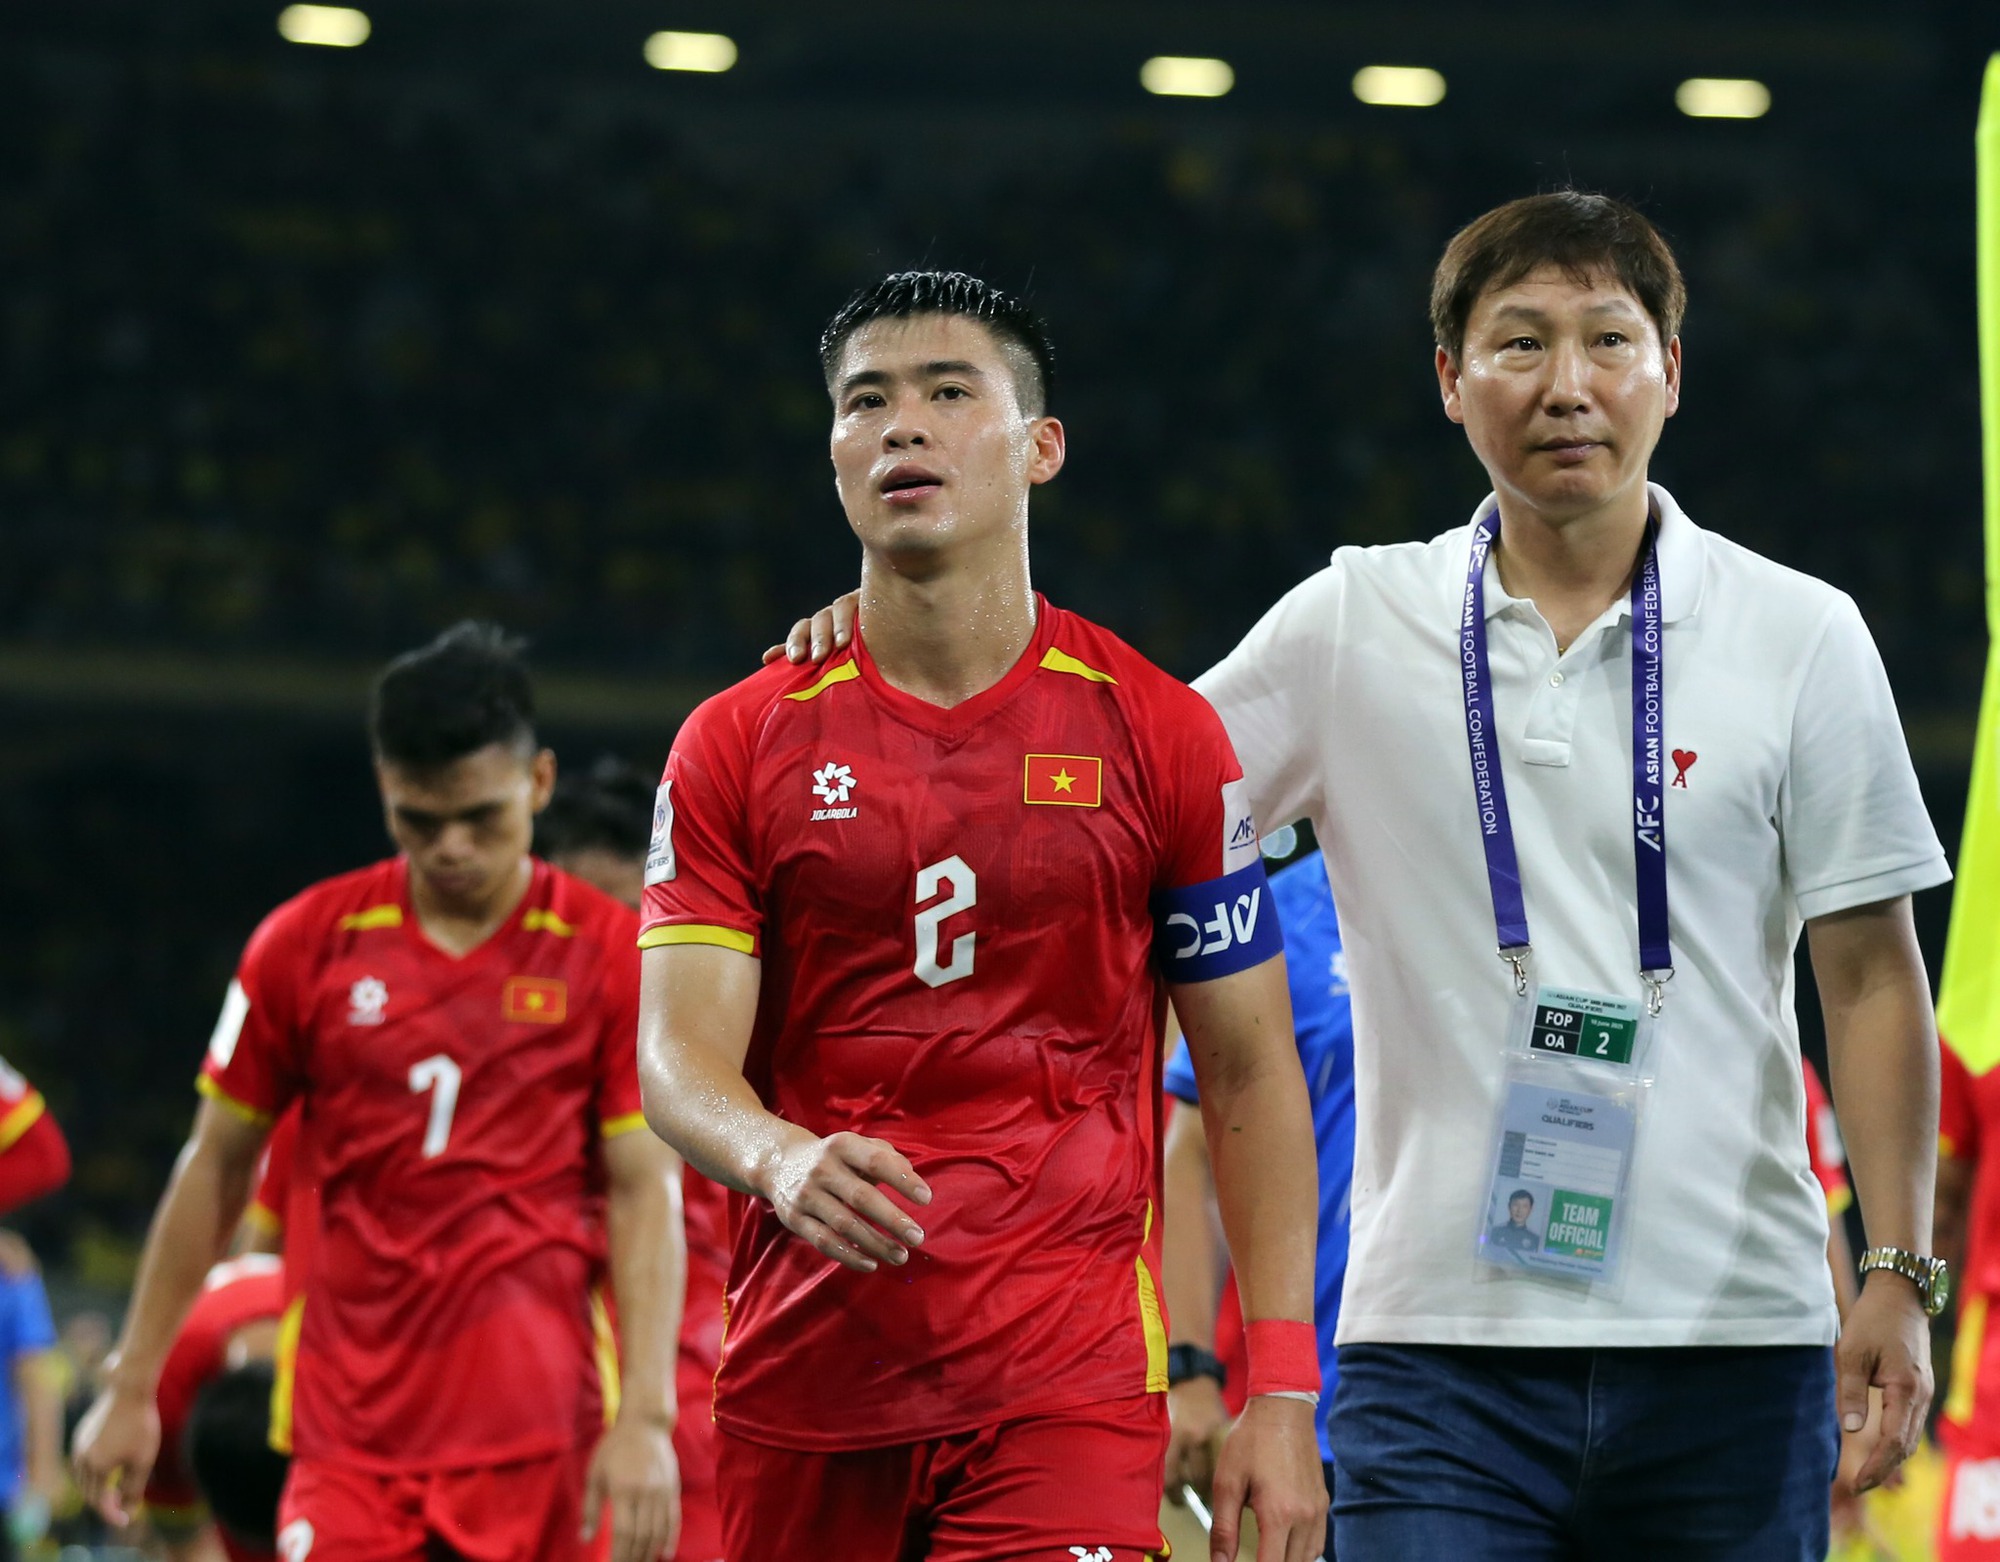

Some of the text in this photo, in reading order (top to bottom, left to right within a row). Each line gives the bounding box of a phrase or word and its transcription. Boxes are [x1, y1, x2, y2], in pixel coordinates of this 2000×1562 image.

[1463, 525, 1497, 835] AFC ASIAN FOOTBALL CONFEDERATION
[1645, 655, 1658, 733] FOOTBALL
[1647, 737, 1659, 785] ASIAN
[810, 807, 858, 821] JOGARBOLA
[1636, 795, 1661, 852] AFC
[1231, 816, 1254, 843] AF
[913, 854, 977, 988] 2
[1167, 887, 1261, 959] AFC
[1545, 1011, 1573, 1027] FOP
[1545, 1033, 1565, 1049] OA
[1595, 1031, 1610, 1055] 2
[408, 1053, 462, 1160] 7
[1541, 1114, 1595, 1131] QUALIFIERS
[1562, 1202, 1600, 1227] TEAM
[1548, 1222, 1604, 1249] OFFICIAL
